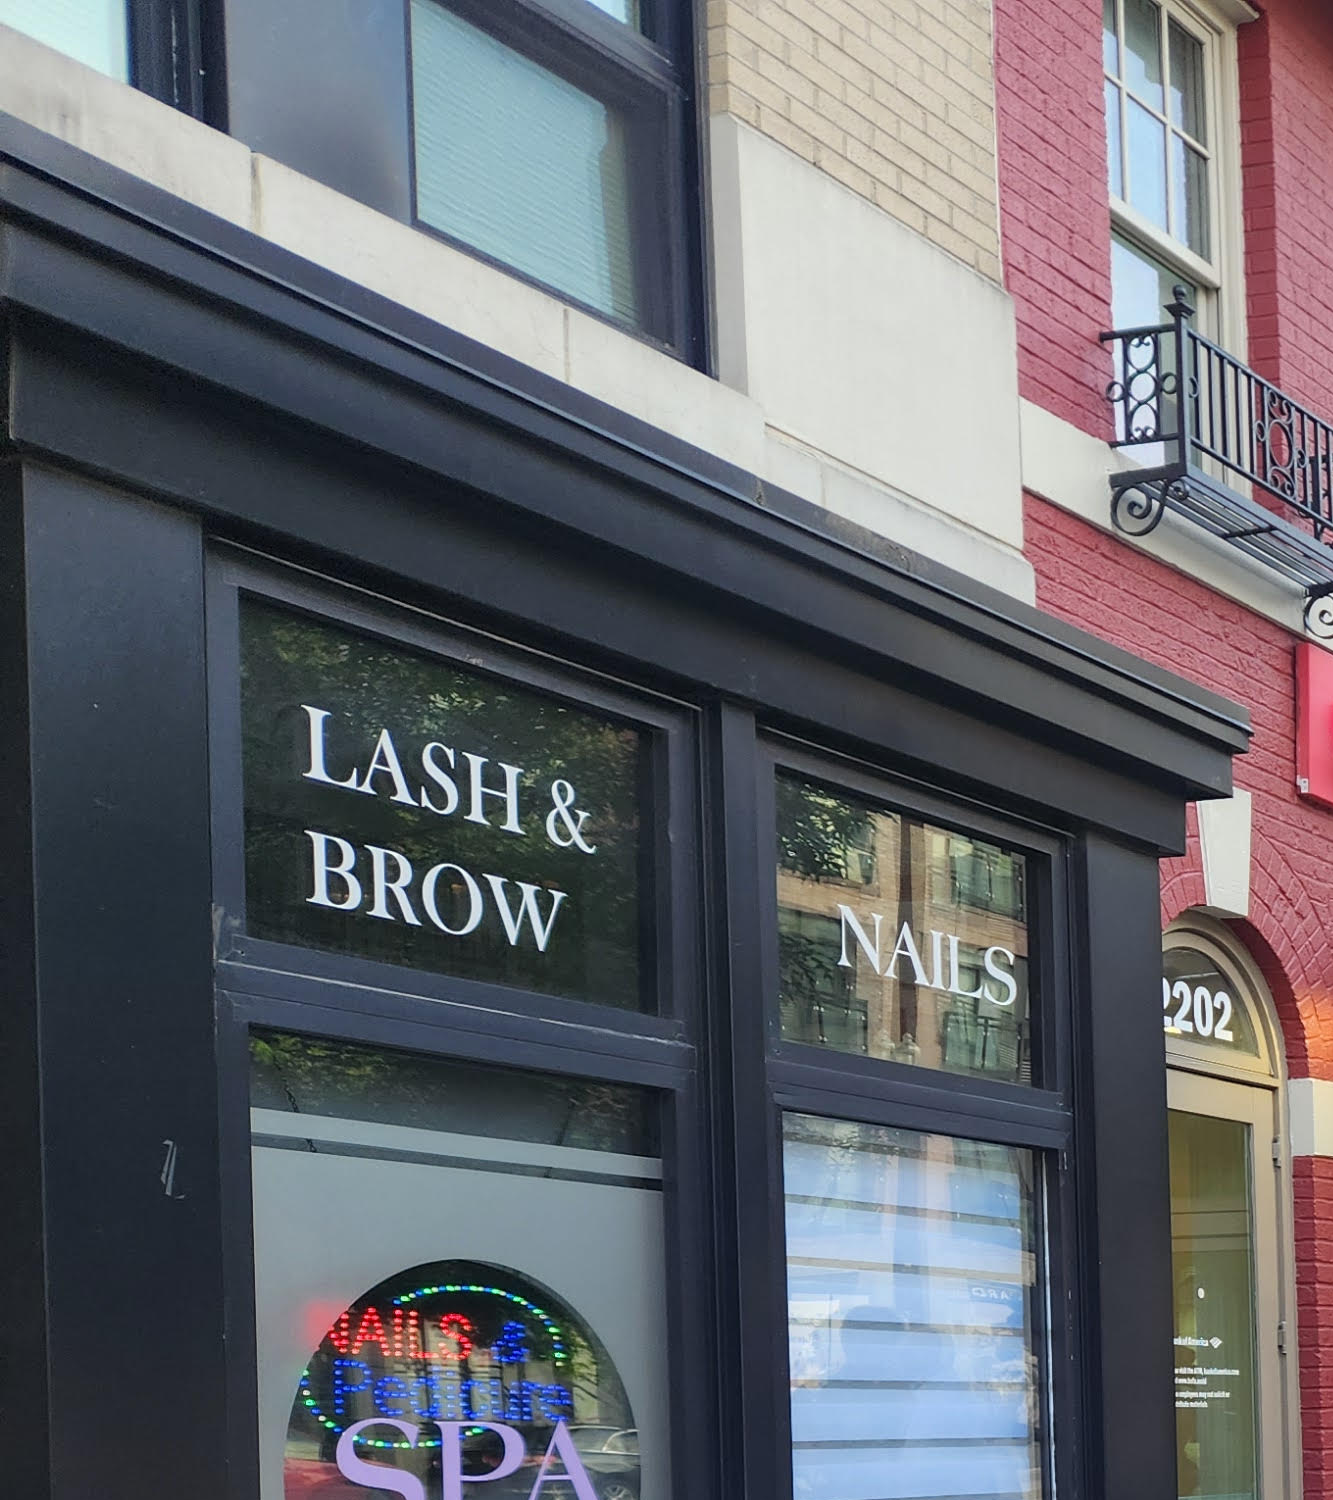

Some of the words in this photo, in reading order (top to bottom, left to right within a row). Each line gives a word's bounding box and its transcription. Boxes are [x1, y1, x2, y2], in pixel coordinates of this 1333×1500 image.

[301, 704, 526, 836] LASH
[544, 778, 597, 854] &
[303, 829, 567, 953] BROW
[837, 904, 1018, 1006] NAILS
[332, 1357, 575, 1421] Pedicure
